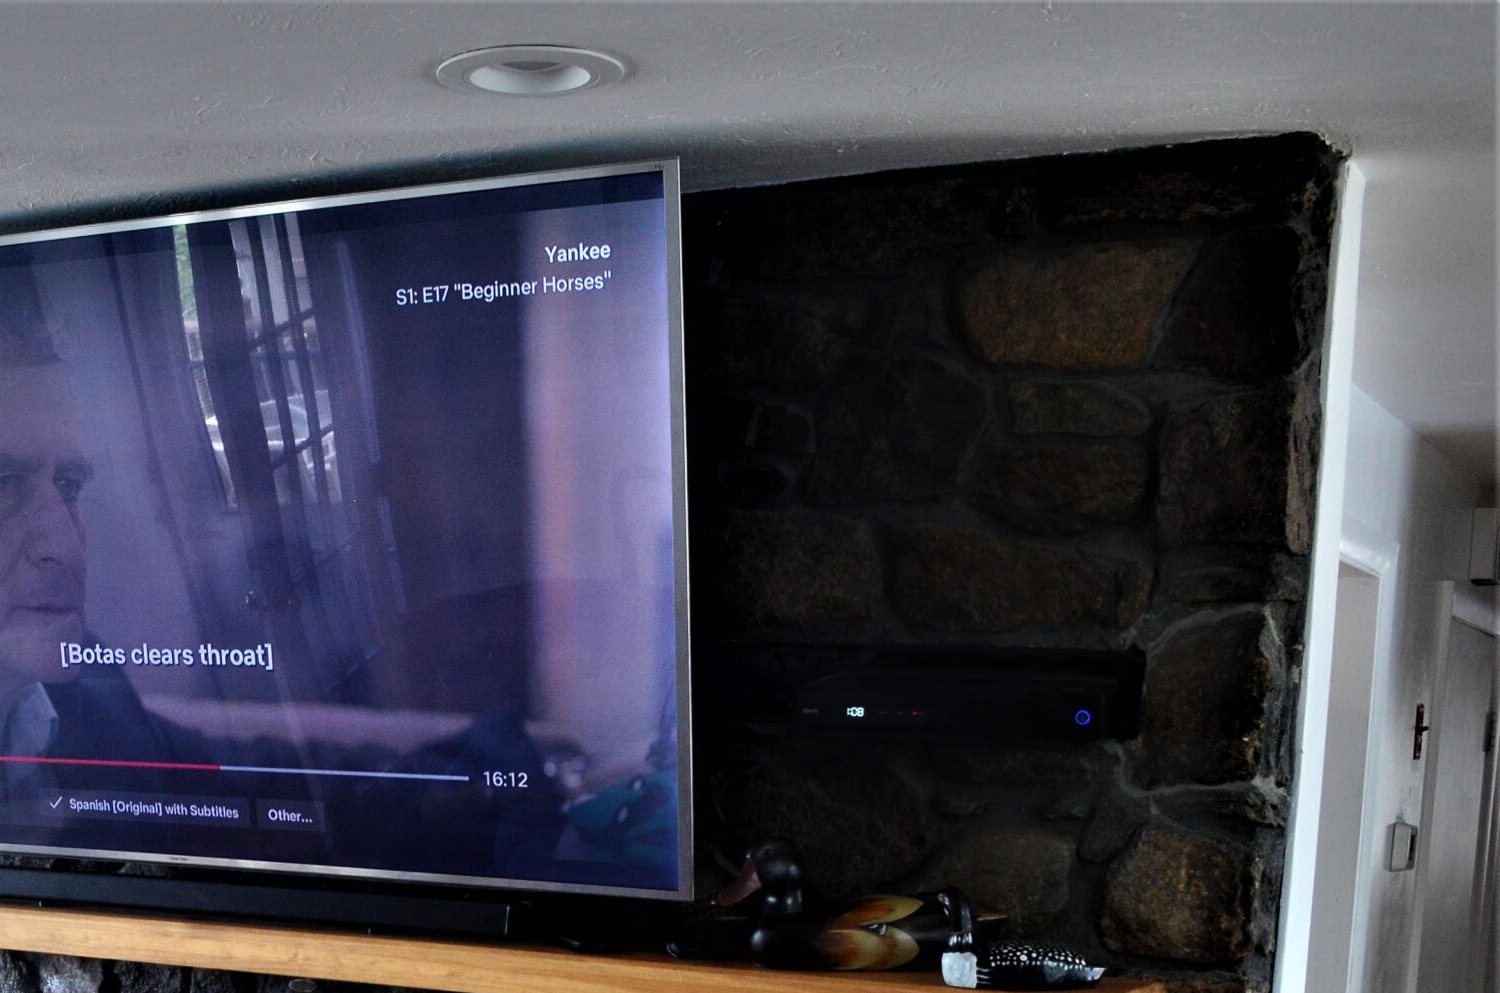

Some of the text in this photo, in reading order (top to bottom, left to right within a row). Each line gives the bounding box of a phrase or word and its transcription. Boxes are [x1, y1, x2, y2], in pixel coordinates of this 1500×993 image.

[544, 242, 611, 263] Yankee
[395, 270, 612, 305] S1: E17 "Beginner Horses"
[60, 641, 274, 670] [Botas clears throat]
[483, 770, 529, 788] 16:12
[69, 797, 239, 820] Spanish [Original] with Subtitles
[267, 808, 313, 824] Other...
